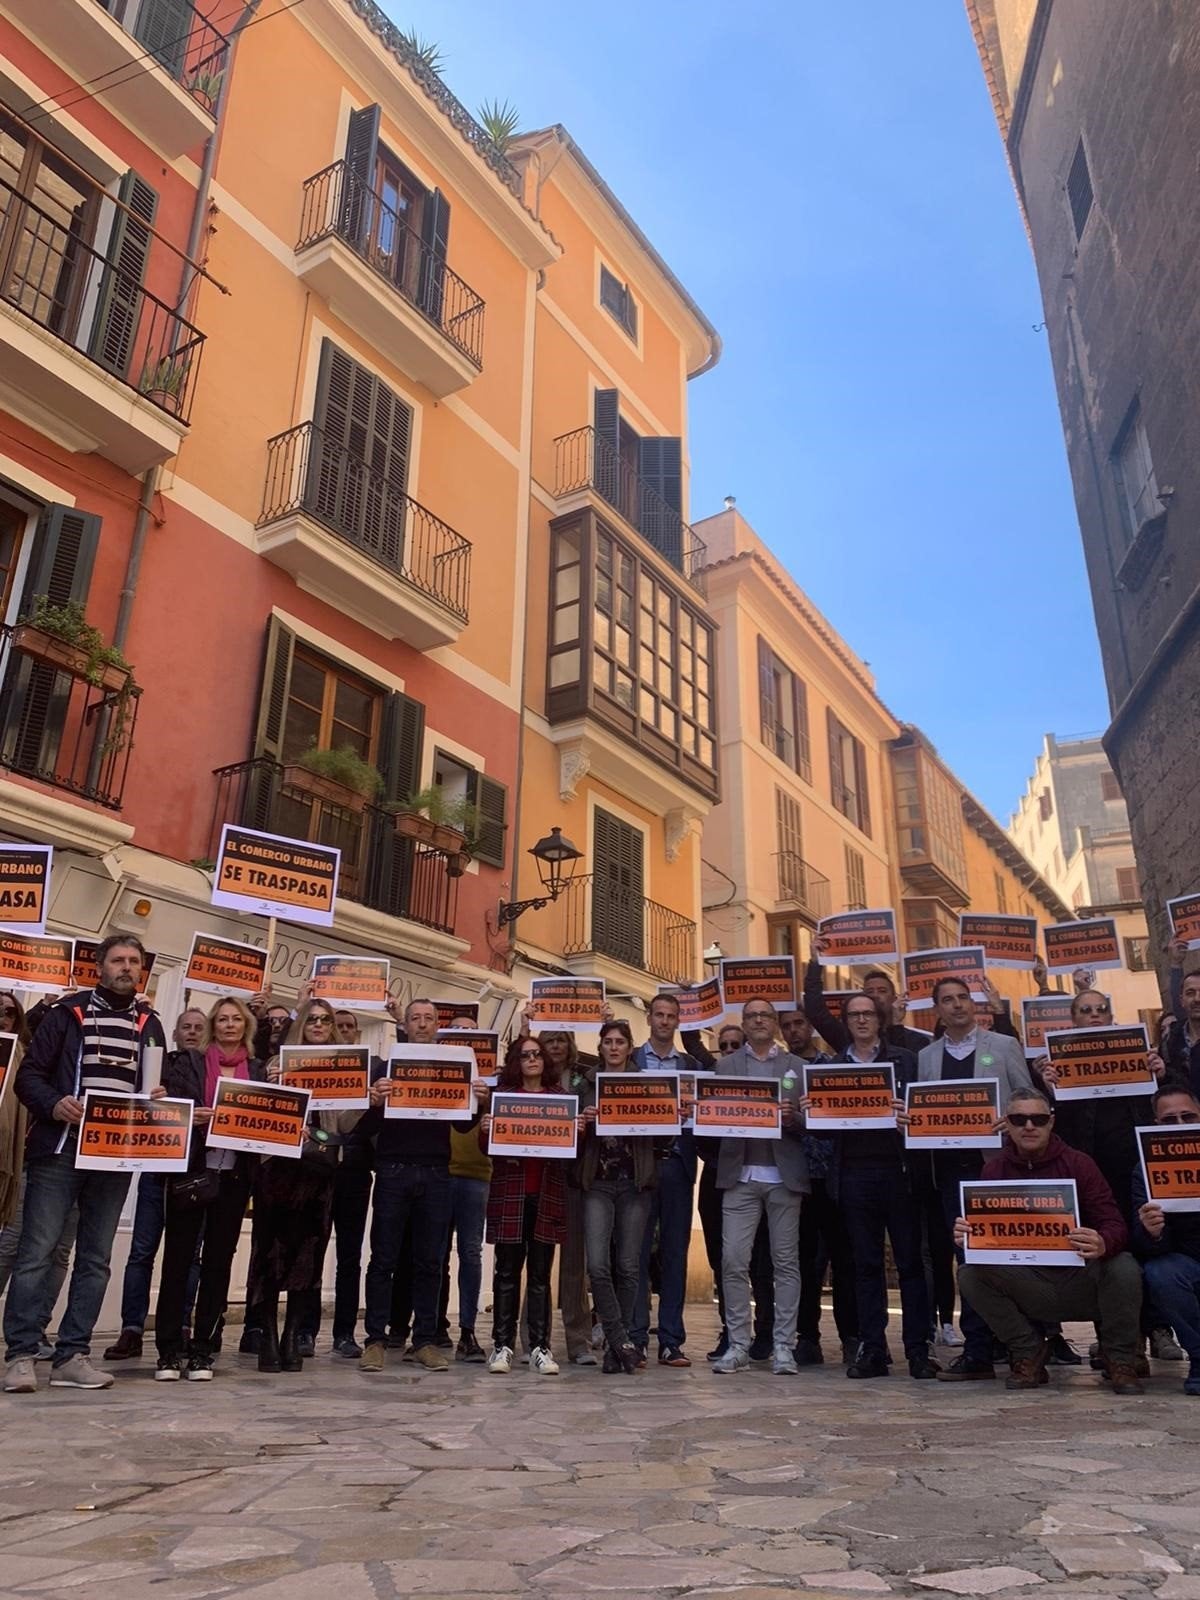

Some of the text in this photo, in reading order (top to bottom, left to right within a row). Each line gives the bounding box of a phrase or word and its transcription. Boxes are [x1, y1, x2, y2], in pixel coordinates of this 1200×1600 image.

[227, 841, 237, 851] EL
[240, 844, 290, 862] COMERCIO
[294, 856, 333, 871] URBANO
[0, 864, 43, 874] RBANO
[224, 865, 242, 880] SE
[249, 869, 327, 898] TRASPASA
[2, 940, 64, 956] COMERÇ URBÀ
[835, 935, 890, 948] TRASPASSA
[80, 950, 88, 958] EL
[200, 944, 206, 952] EL
[209, 946, 239, 962] COMERÇ
[1050, 944, 1113, 959] ES TRASPASSA
[2, 958, 66, 976] TRASPASSA
[73, 966, 83, 976] ES
[192, 961, 259, 982] ES TRASPASSA
[317, 981, 381, 992] ES TRASPASSA
[727, 984, 790, 995] ES TRASPASSA
[910, 981, 920, 991] ES
[534, 1003, 600, 1014] SE TRASPASA
[1030, 1009, 1039, 1017] EL
[1030, 1028, 1040, 1037] ES
[1051, 1038, 1144, 1053] EL COMERCIO URBANO
[289, 1056, 361, 1069] EL COMERÇ URBÀ
[1057, 1058, 1148, 1077] SE TRASPASA
[396, 1067, 464, 1080] EL COMERÇ URBÀ
[285, 1078, 362, 1088] ES TRASPASSA
[812, 1075, 885, 1088] EL COMERÇ URBÀ
[392, 1087, 465, 1099] ES TRASPASSA
[604, 1086, 613, 1094] EL
[615, 1085, 647, 1096] COMERÇ
[649, 1083, 671, 1094] URBÀ
[703, 1088, 712, 1096] EL
[714, 1088, 747, 1099] COMERÇ
[224, 1092, 233, 1102] EL
[237, 1094, 273, 1110] COMERÇ
[275, 1100, 298, 1112] URBÀ
[811, 1096, 889, 1108] ES TRASPASSA
[914, 1090, 989, 1105] EL COMERÇ URBÀ
[93, 1107, 180, 1123] EL COMERÇ URBÀ
[511, 1105, 544, 1117] COMERÇ
[546, 1104, 568, 1116] URBÀ
[602, 1104, 674, 1115] ES TRASPASSA
[700, 1106, 774, 1118] ES TRASPASSA
[217, 1113, 297, 1135] ES TRASPASSA
[911, 1113, 992, 1126] ES TRASPASSA
[496, 1123, 570, 1137] ES TRASPASSA
[86, 1130, 181, 1146] ES TRASPASSA
[1152, 1144, 1165, 1155] EL
[1152, 1170, 1169, 1185] ES
[972, 1195, 1064, 1211] EL COMERÇ URBÀ
[972, 1222, 1070, 1237] ES TRASPASSA
